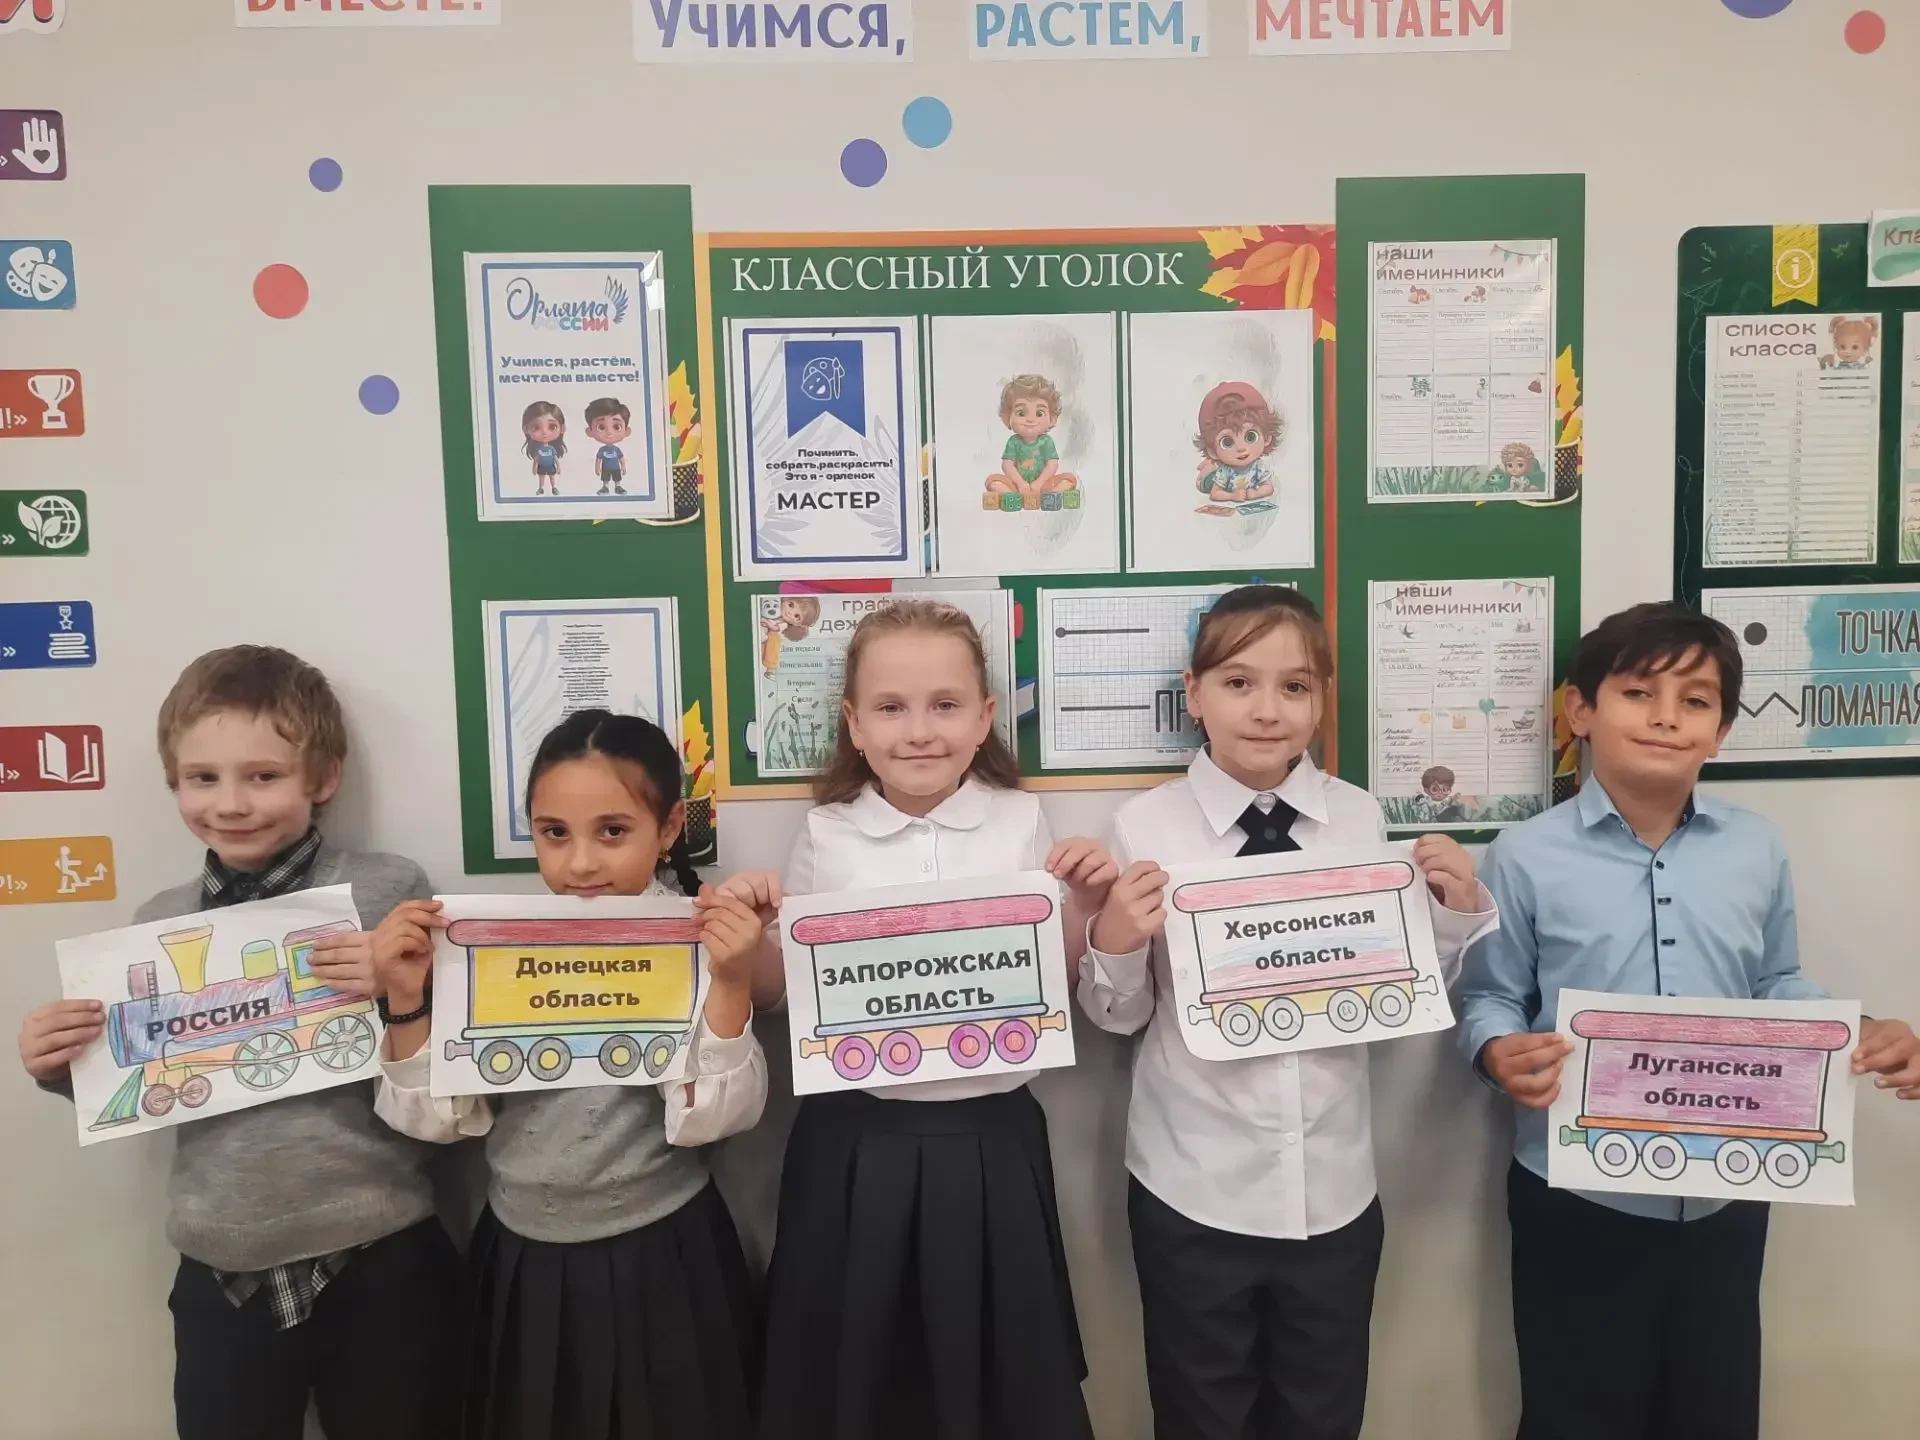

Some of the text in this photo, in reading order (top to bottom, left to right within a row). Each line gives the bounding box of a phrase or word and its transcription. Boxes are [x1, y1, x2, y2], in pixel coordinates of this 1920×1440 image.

[650, 0, 905, 56] УЧИМСЯ,
[976, 1, 1200, 52] РАСТЕМ,
[1256, 0, 1504, 40] МЕЧТАЕМ
[1376, 248, 1433, 261] наши
[731, 246, 1184, 292] КЛАССНЫЙ УГОЛОК
[1376, 267, 1505, 281] именинники
[506, 277, 609, 325] Орлята
[1725, 323, 1817, 337] список
[1729, 343, 1817, 357] класса
[500, 356, 568, 368] Учимся,
[499, 371, 640, 384] мечтаем вместе!
[785, 472, 807, 481] Это
[777, 491, 881, 510] МАСТЕР
[1396, 586, 1452, 598] наши
[1396, 601, 1522, 615] именинники
[1836, 610, 1920, 655] ТОЧКА
[1224, 909, 1376, 940] Херсонская
[515, 957, 652, 979] Донецкая
[822, 949, 1032, 987] ЗАПОРОЖСКАЯ
[1255, 946, 1356, 970] область
[529, 990, 640, 1009] область
[865, 987, 995, 1016] ОБЛАСТЬ
[147, 997, 270, 1041] РОССИЯ
[1628, 1052, 1783, 1078] Луганская
[1644, 1087, 1761, 1110] область
